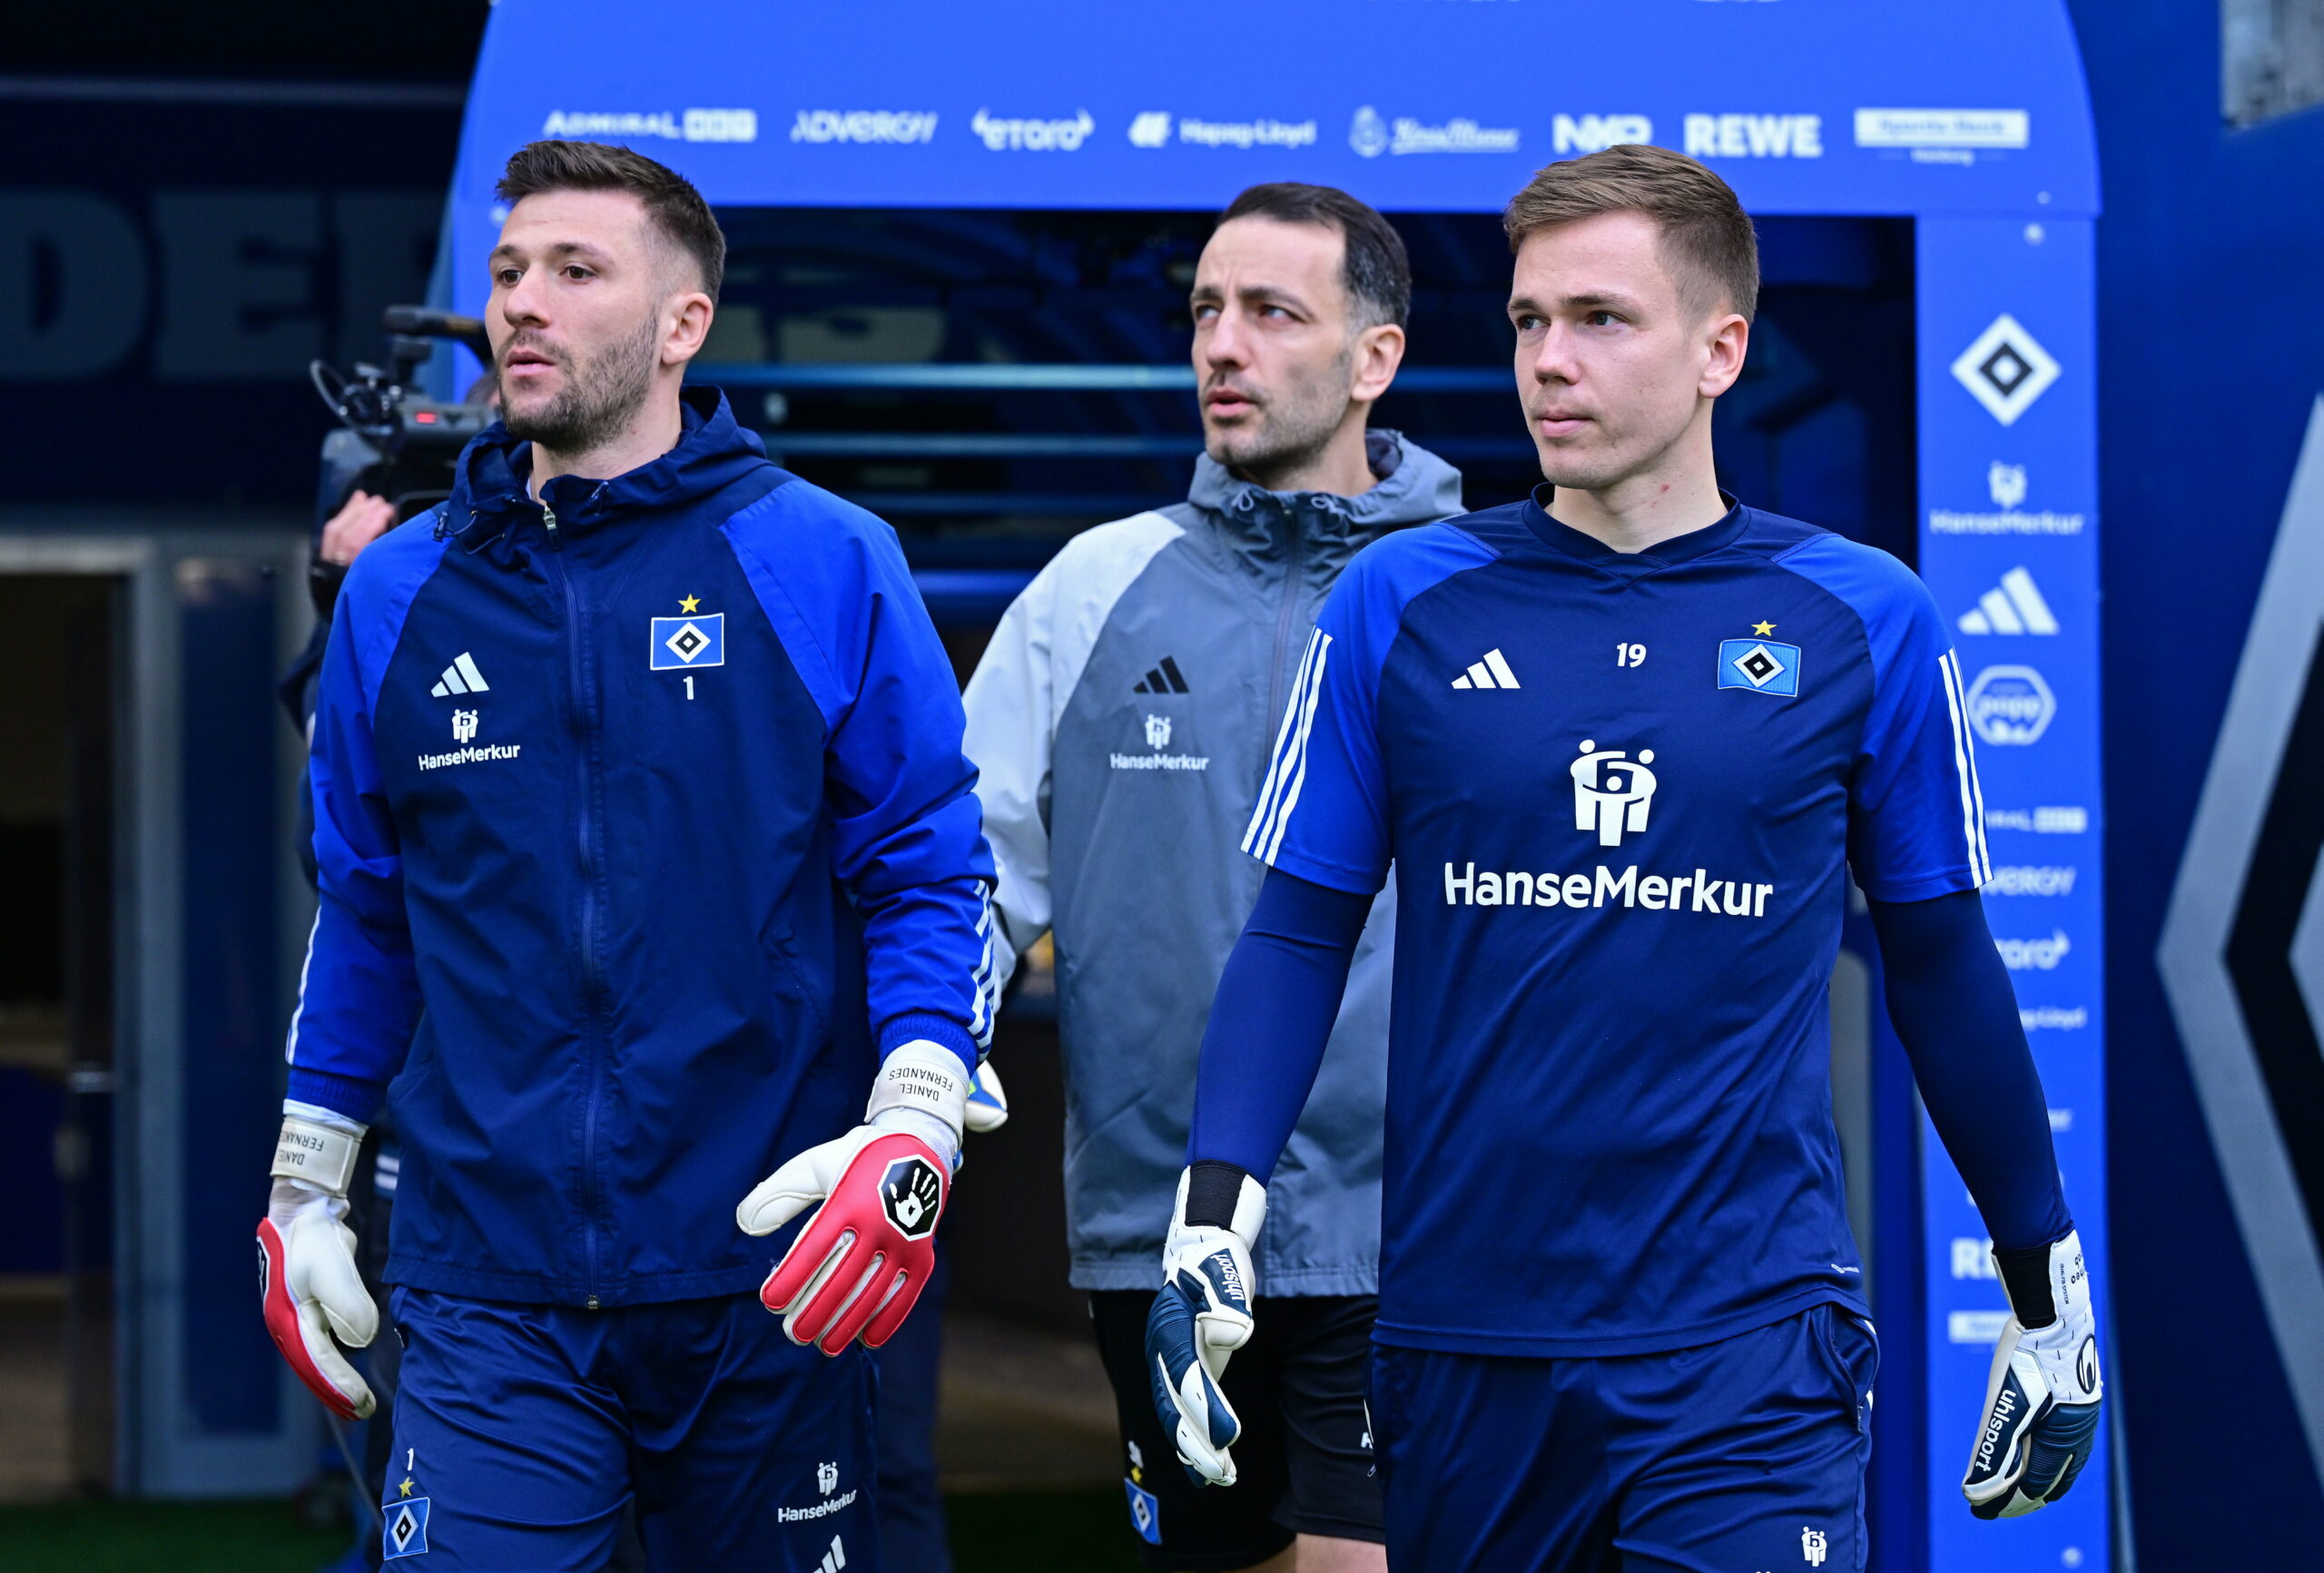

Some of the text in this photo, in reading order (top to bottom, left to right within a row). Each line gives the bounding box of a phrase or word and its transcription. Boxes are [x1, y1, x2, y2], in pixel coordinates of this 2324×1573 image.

[1684, 113, 1823, 158] REWE
[1929, 510, 2084, 536] HanseMerkur
[1616, 643, 1647, 668] 19
[683, 675, 694, 700] 1
[418, 743, 521, 771] HanseMerkur
[1109, 752, 1210, 771] HanseMerkur
[1444, 861, 1774, 918] HanseMerkur
[889, 1067, 953, 1092] FERNANDES
[900, 1083, 940, 1101] DANIEL
[1210, 1253, 1245, 1301] uhlsport
[1975, 1389, 2016, 1472] uhlsport
[407, 1448, 414, 1471] 1
[777, 1489, 857, 1523] HanseMerkur
